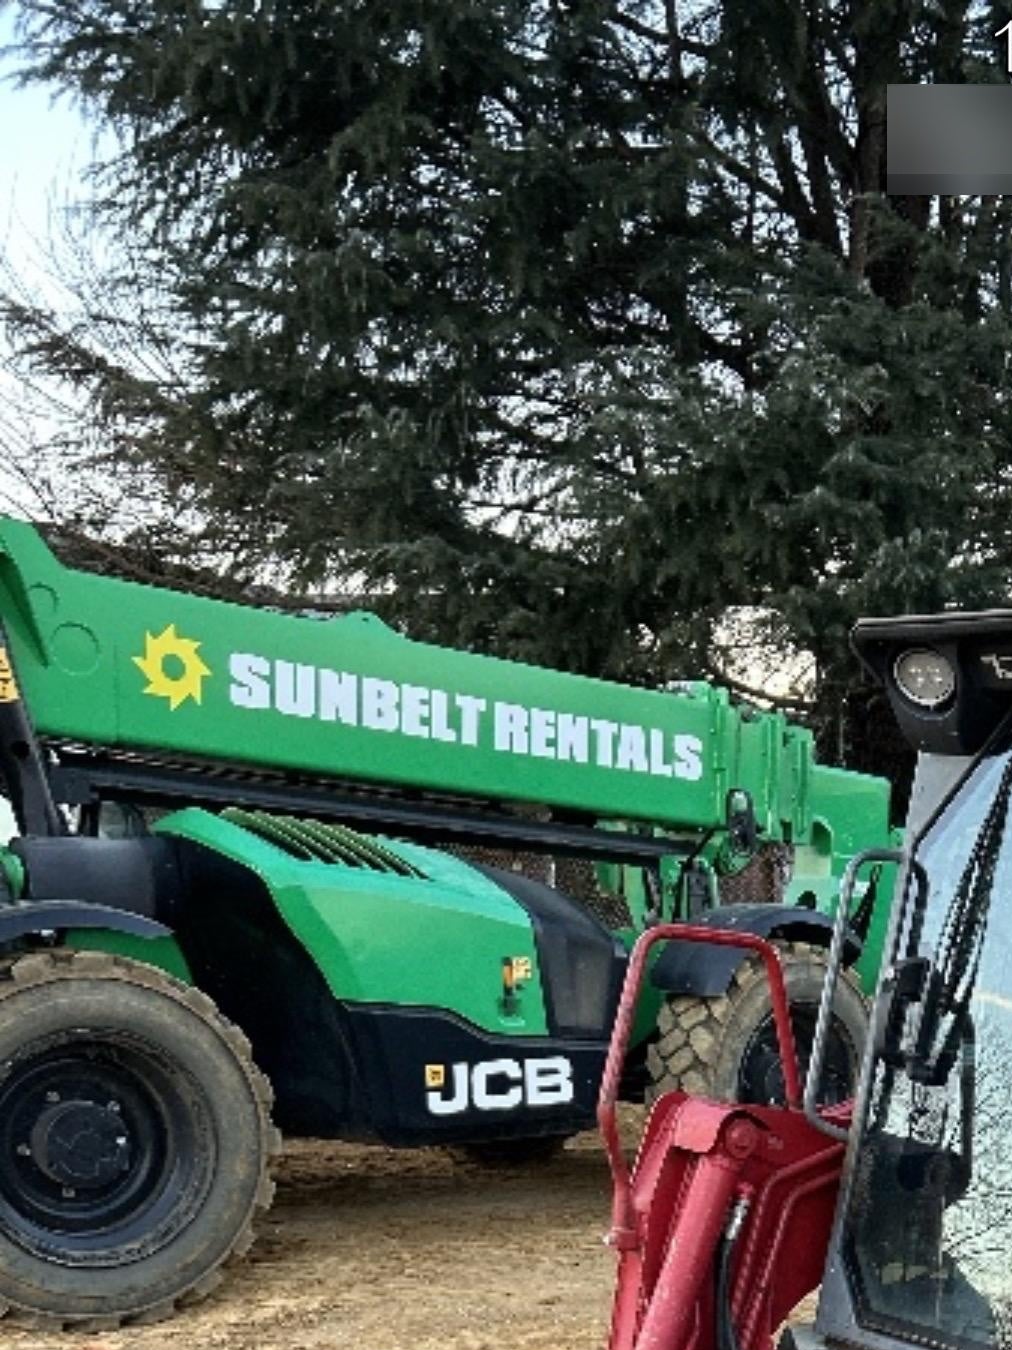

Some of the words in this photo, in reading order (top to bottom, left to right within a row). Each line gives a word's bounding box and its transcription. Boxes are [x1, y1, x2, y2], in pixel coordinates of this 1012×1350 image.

[229, 652, 487, 747] SUNBELT
[494, 701, 704, 781] RENTALS
[425, 1055, 574, 1115] JCB
